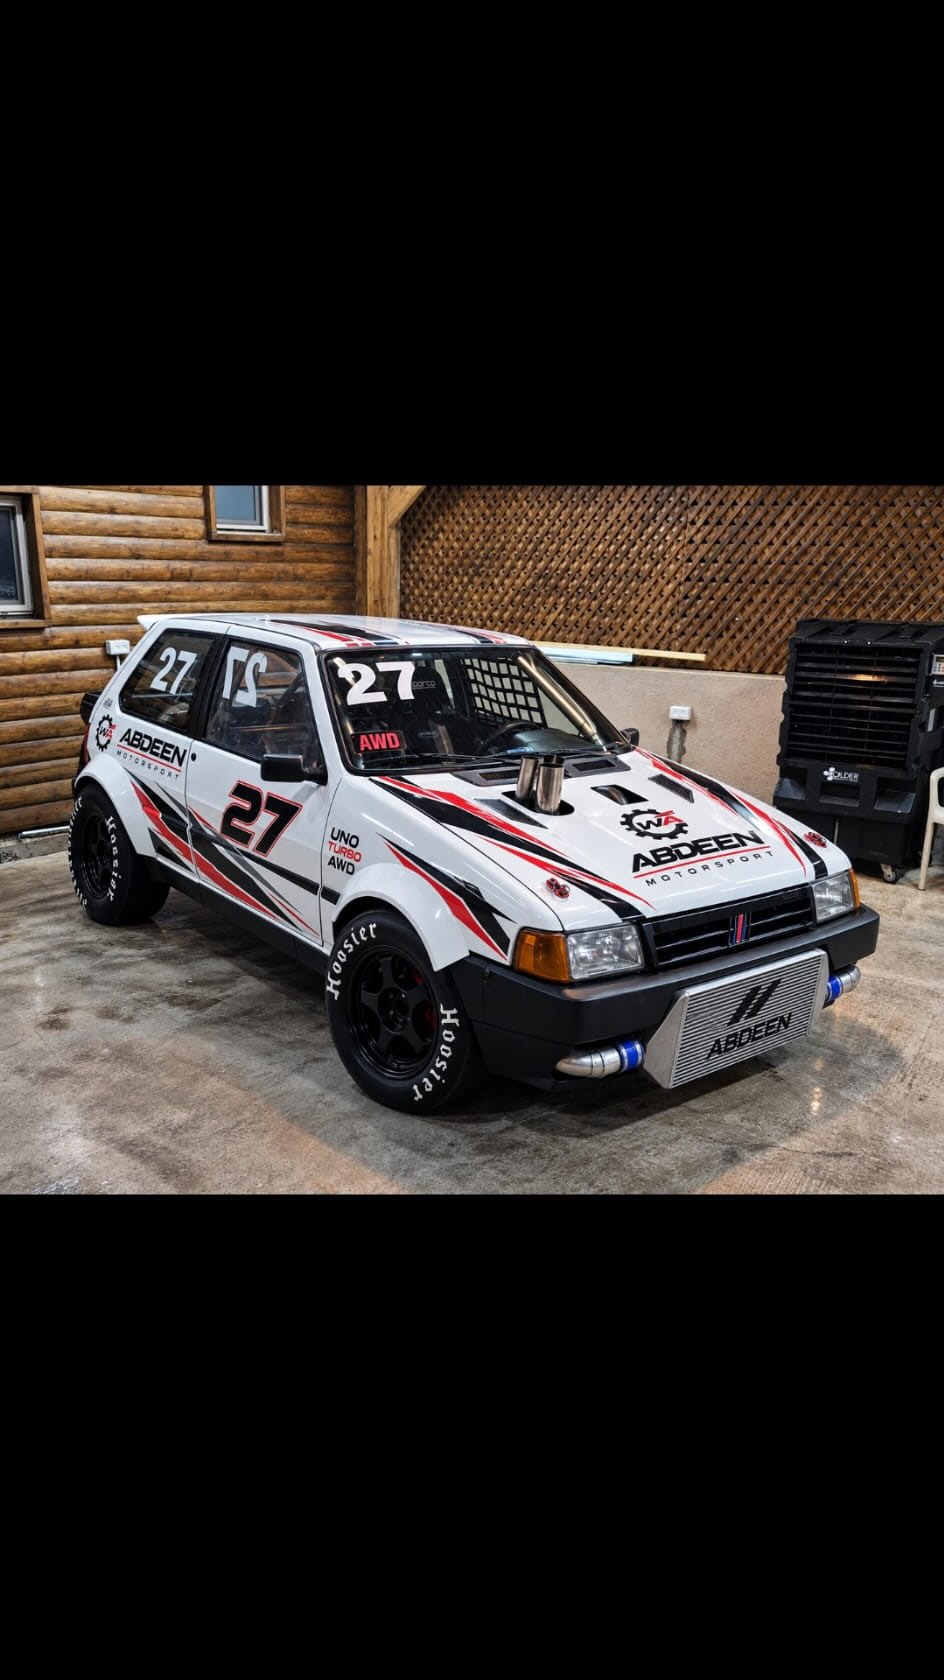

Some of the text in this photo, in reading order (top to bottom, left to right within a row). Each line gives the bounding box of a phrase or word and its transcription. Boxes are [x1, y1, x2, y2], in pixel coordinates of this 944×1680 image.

[150, 647, 197, 695] 27
[338, 661, 415, 706] 27
[412, 680, 436, 691] parco
[119, 728, 187, 766] ABDEEN
[360, 732, 400, 751] AWD
[117, 750, 180, 780] MOTORSPORT
[220, 780, 303, 858] 27
[330, 827, 360, 848] UNO
[104, 816, 121, 902] Hoosier
[327, 855, 355, 876] AWD
[328, 841, 362, 863] TURBO
[632, 830, 765, 873] ABDEEN
[645, 851, 773, 886] MOTORSPORT
[326, 922, 377, 1000] Hoosier
[412, 1003, 460, 1101] Hoosier
[705, 1012, 792, 1060] ABDEEN
